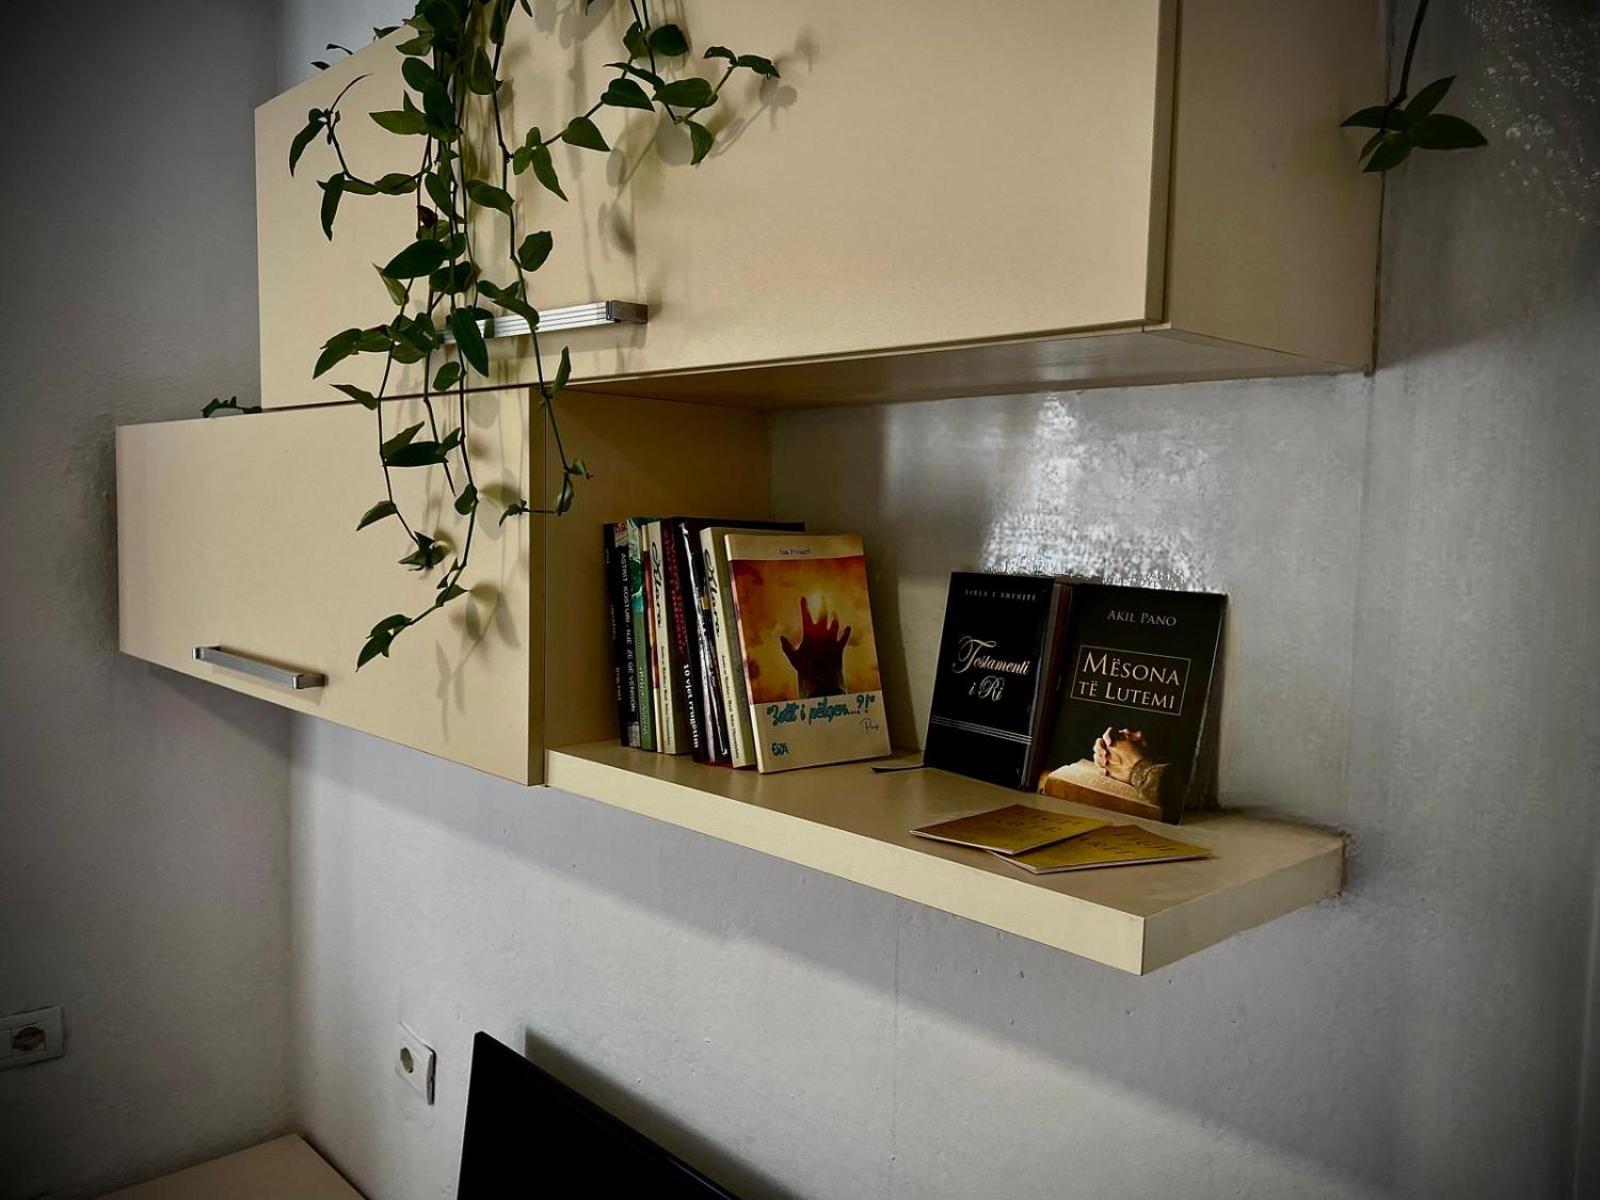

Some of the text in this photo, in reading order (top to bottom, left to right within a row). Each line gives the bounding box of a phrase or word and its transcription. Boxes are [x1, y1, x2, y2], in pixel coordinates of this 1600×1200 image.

[621, 552, 629, 582] ASTRIT
[1107, 610, 1177, 627] AKIL PANO
[952, 635, 1031, 675] Testamenti
[683, 663, 690, 677] 10
[685, 678, 693, 699] vjet
[968, 675, 1005, 702] i Ri
